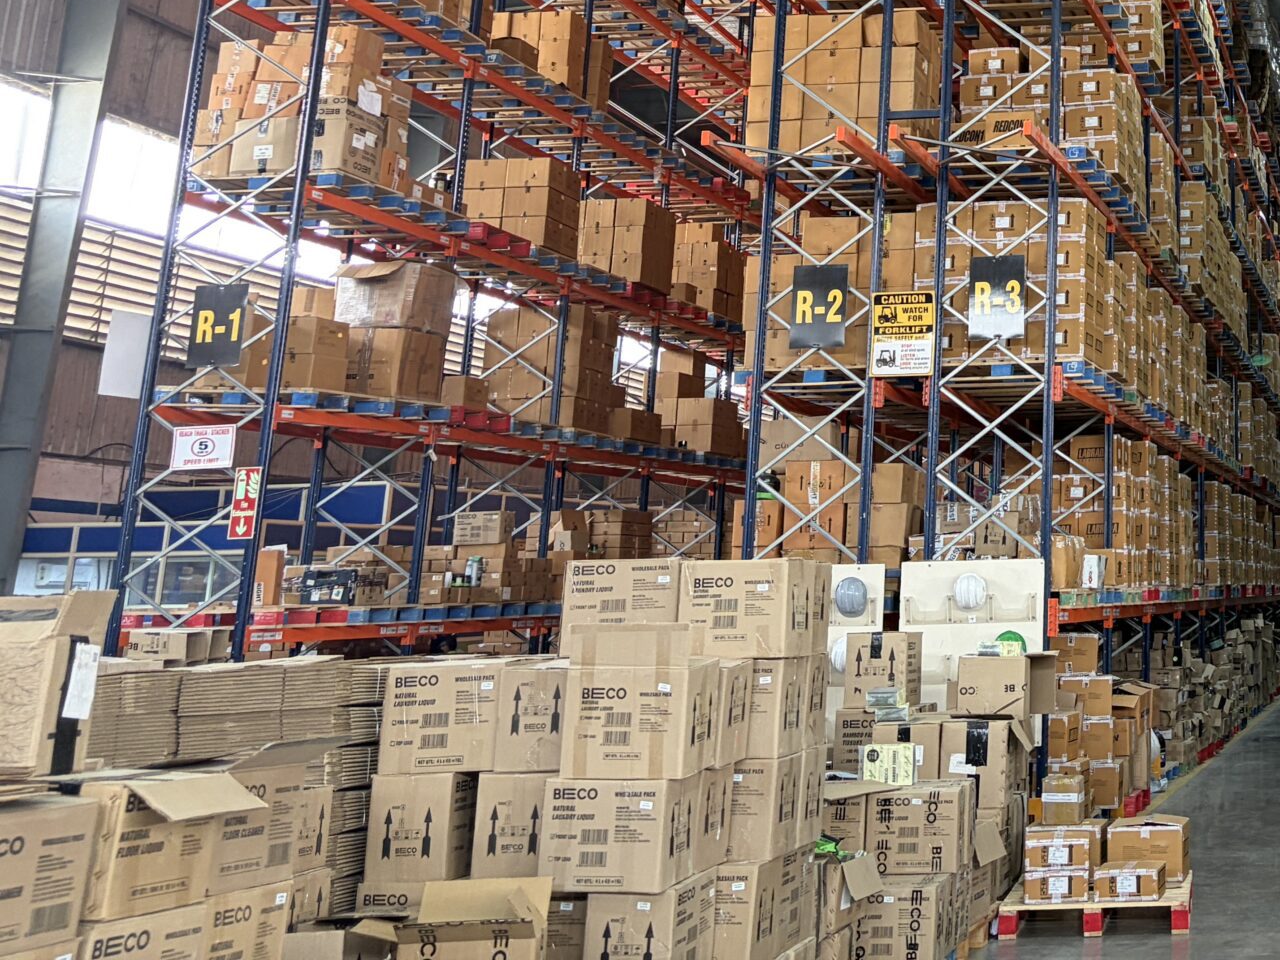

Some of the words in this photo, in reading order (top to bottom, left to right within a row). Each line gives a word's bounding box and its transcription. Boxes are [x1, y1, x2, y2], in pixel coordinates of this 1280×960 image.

[993, 120, 1024, 132] REDCON
[881, 294, 926, 304] CAUTION
[974, 279, 1021, 315] R-3
[795, 289, 843, 324] R-2
[195, 308, 241, 344] R-1
[879, 326, 928, 334] FORKLIFT
[198, 440, 208, 450] 5
[183, 458, 200, 466] SPEED
[573, 564, 616, 576] BECO
[694, 577, 734, 589] BECO
[395, 675, 439, 688] BECO
[582, 688, 627, 699] BECO
[553, 788, 598, 800] BECO
[363, 894, 408, 906] BECO
[213, 905, 252, 928] BECO
[92, 930, 151, 960] BECO
